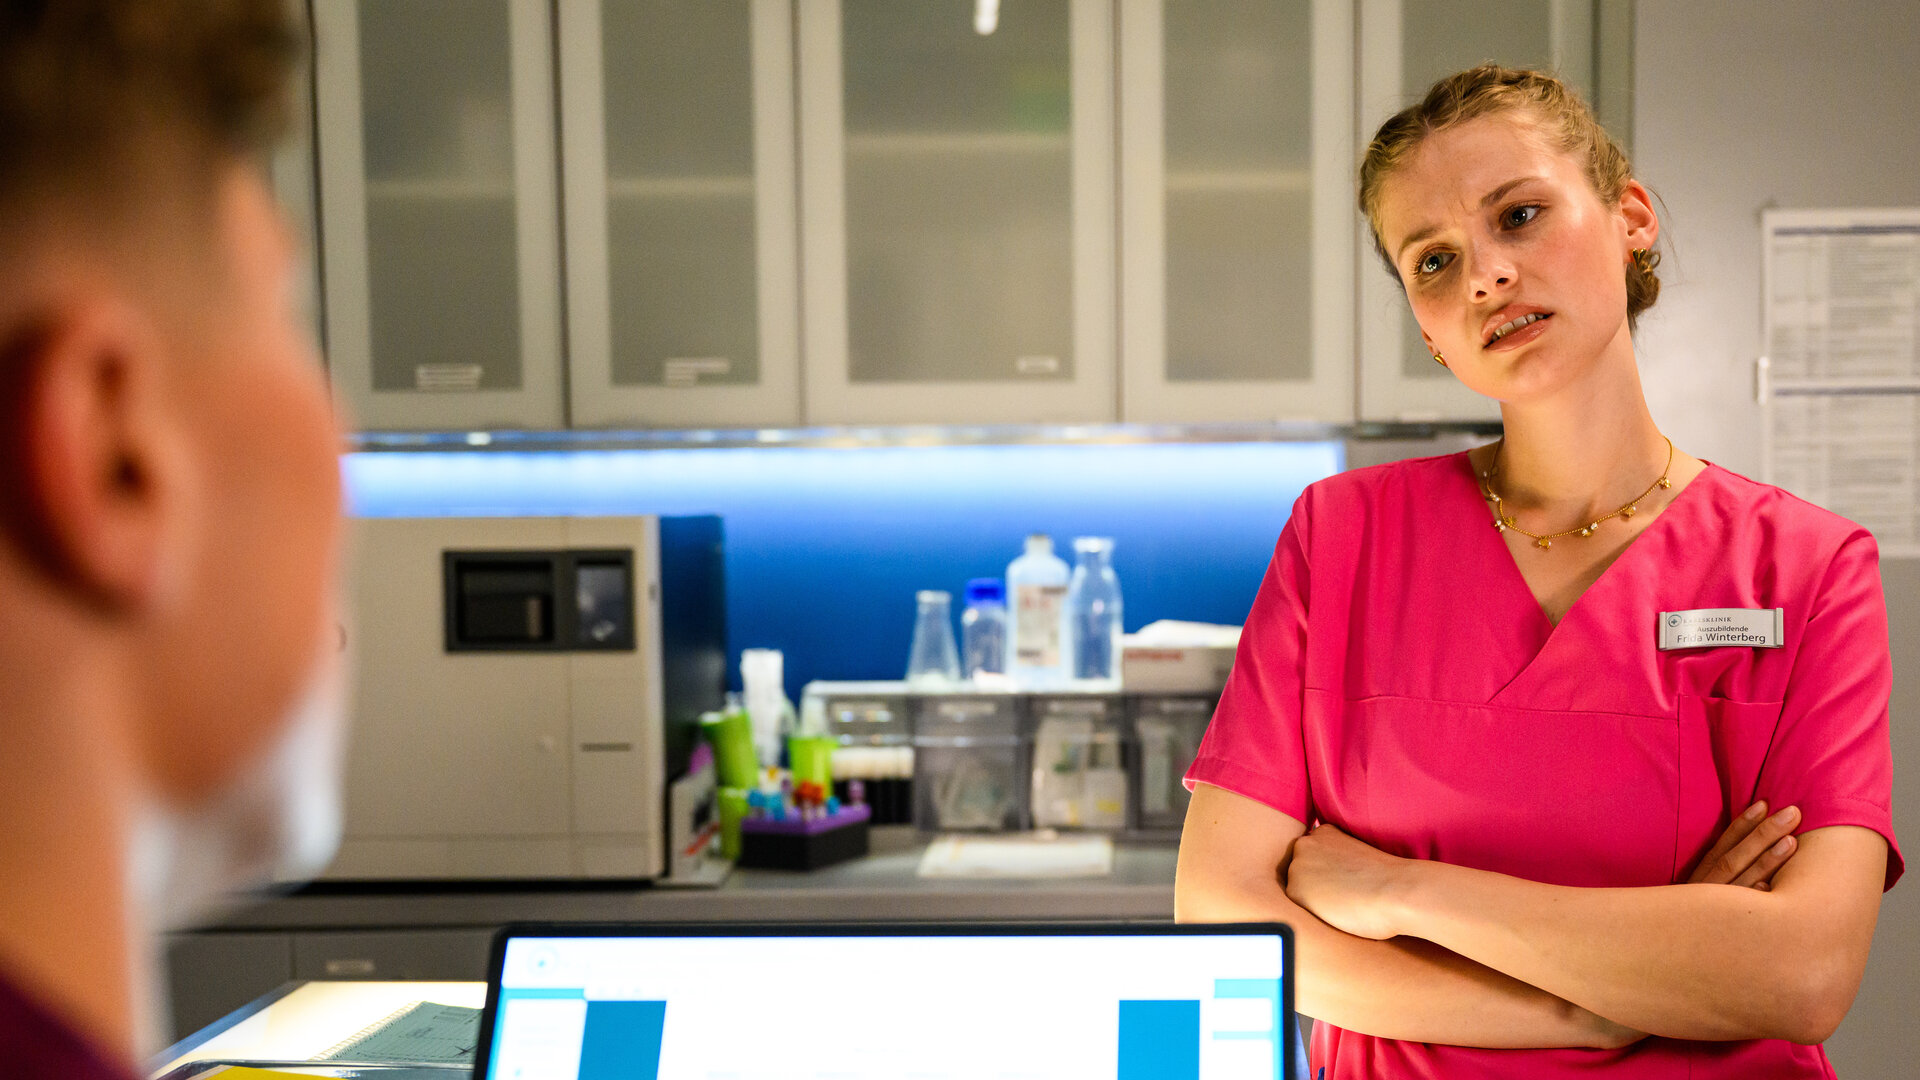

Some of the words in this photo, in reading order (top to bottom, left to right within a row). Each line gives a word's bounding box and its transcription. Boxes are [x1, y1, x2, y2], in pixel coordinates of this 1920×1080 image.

[1683, 616, 1732, 624] KLSKLINIK
[1697, 625, 1749, 633] Auszubildende
[1677, 634, 1703, 643] Frida
[1706, 633, 1766, 645] Winterberg
